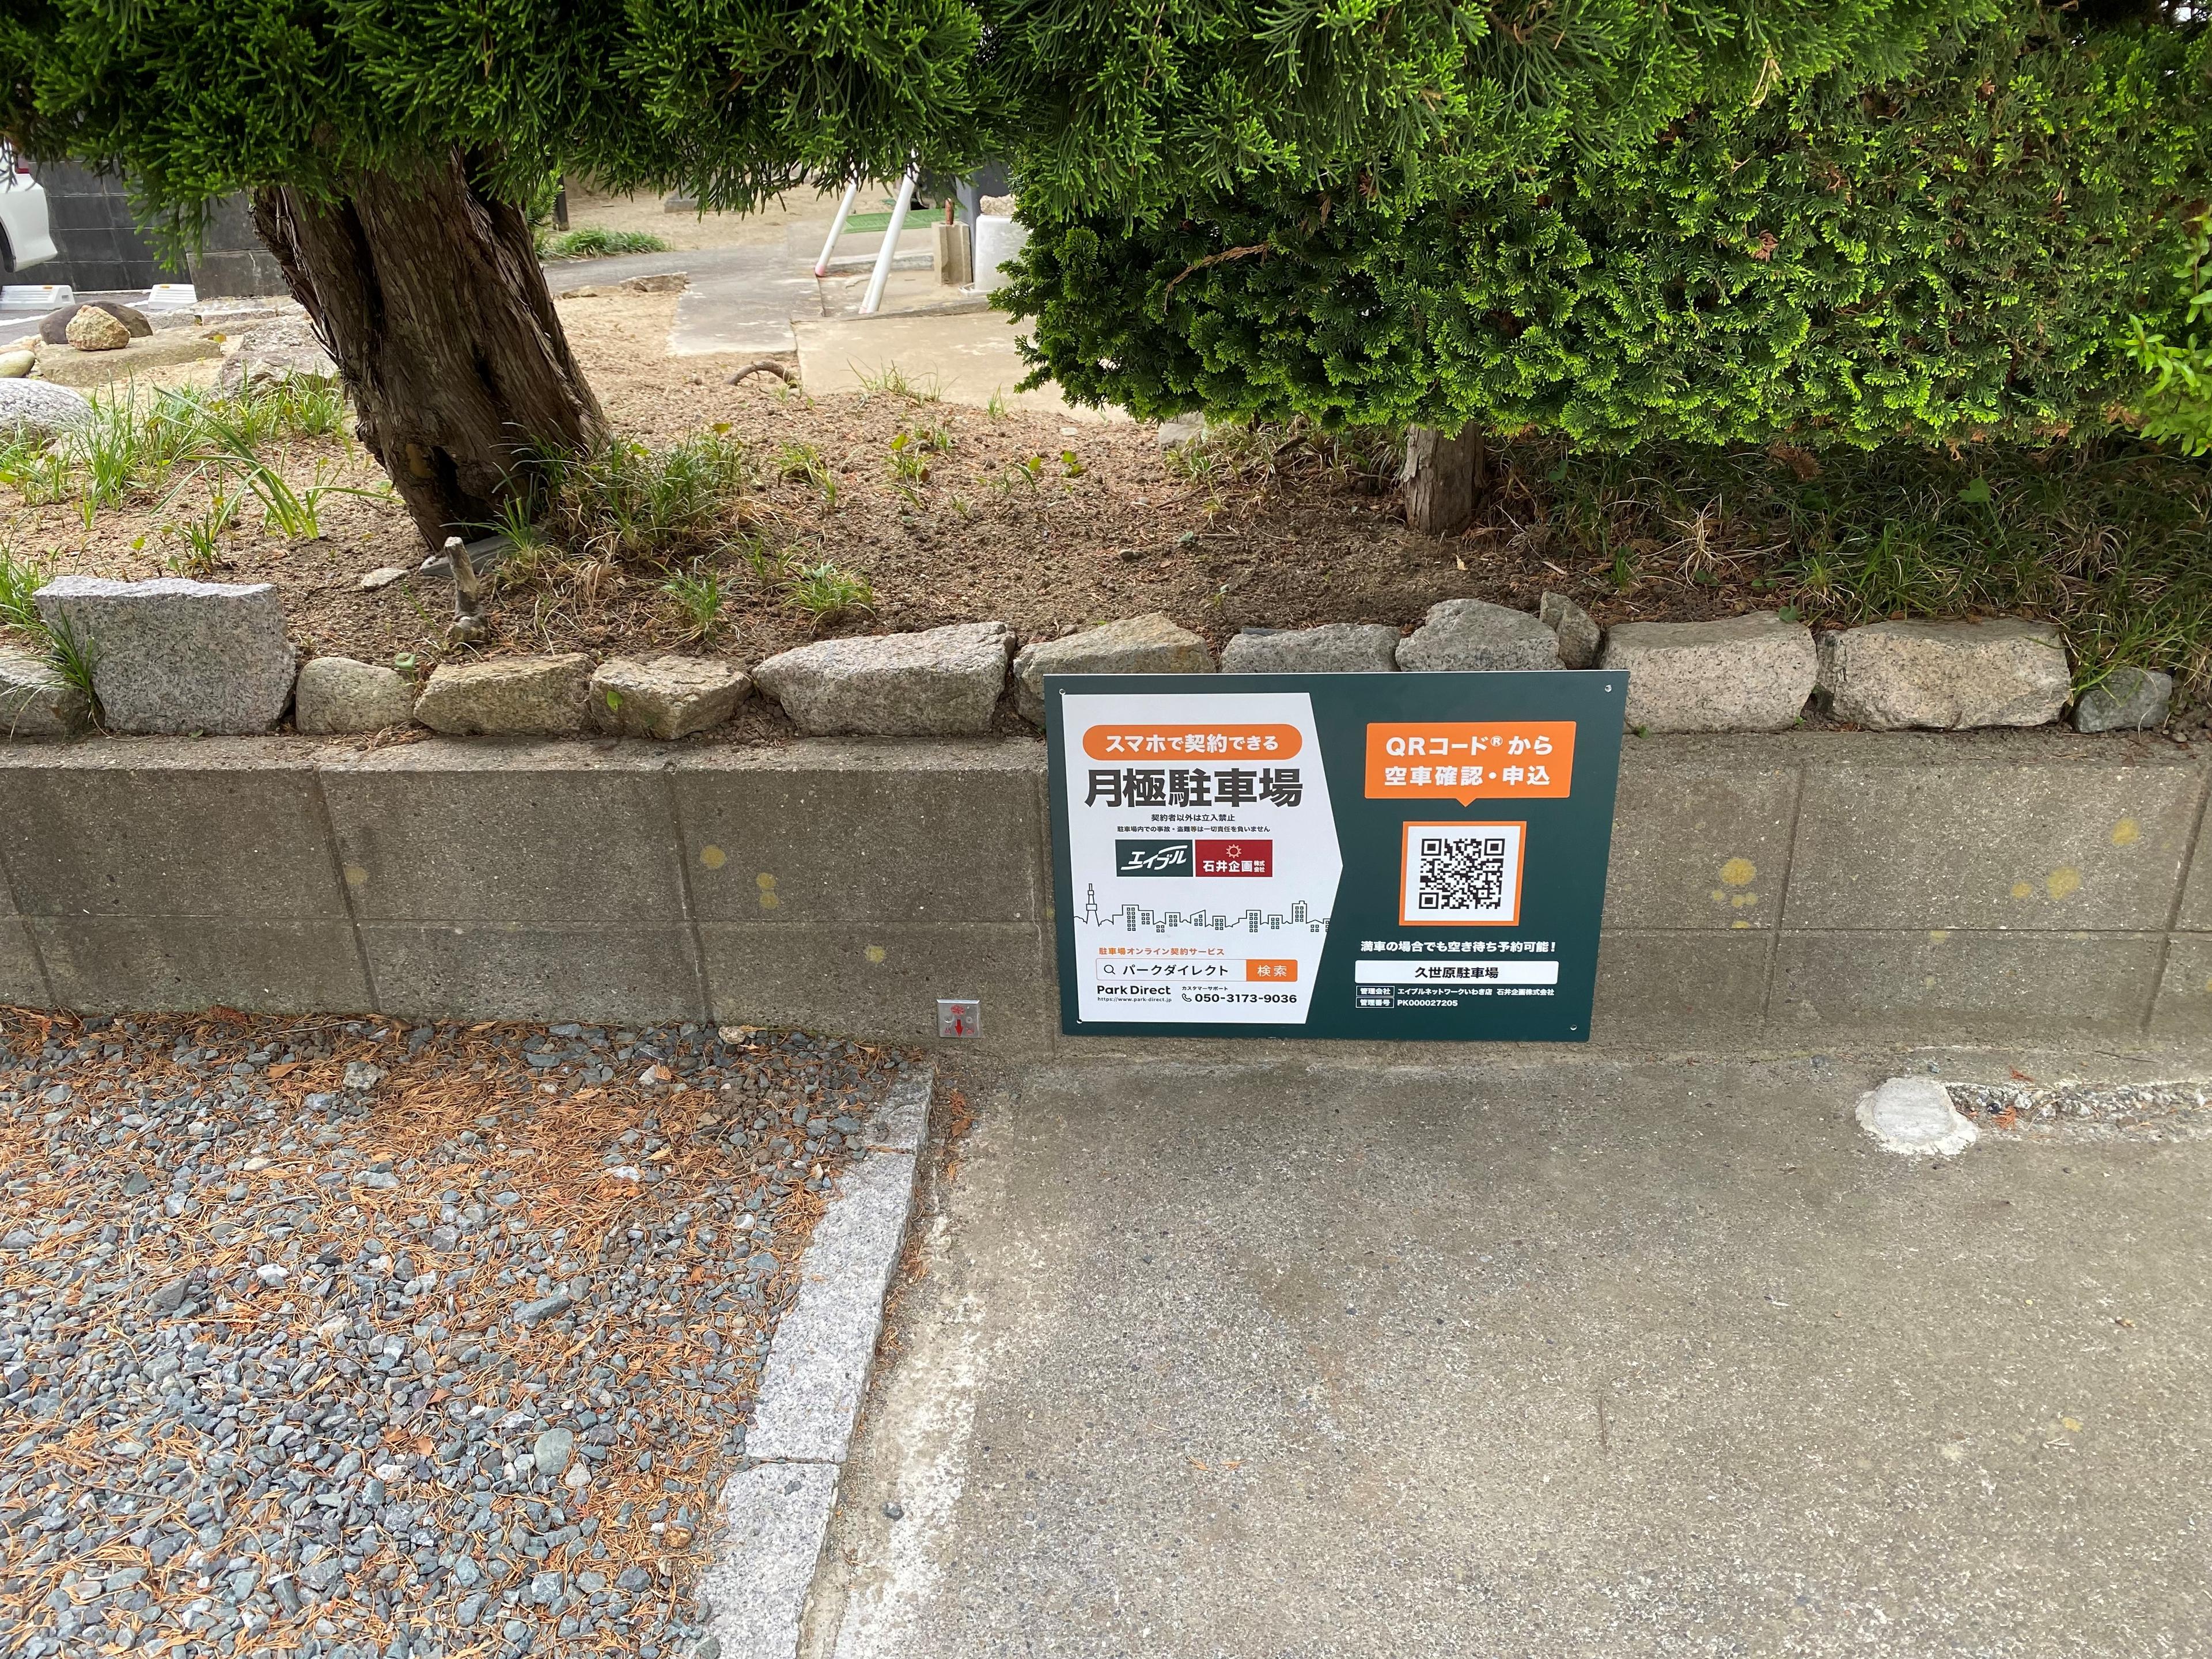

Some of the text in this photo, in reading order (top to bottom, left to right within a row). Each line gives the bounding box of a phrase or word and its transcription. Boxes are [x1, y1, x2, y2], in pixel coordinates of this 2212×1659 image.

[1105, 733, 1278, 753] スマホで契約できる
[1384, 766, 1550, 786] 空車確認・申込
[1085, 768, 1303, 808] 月極駐車場
[1151, 814, 1236, 822] 契約者以外は立入禁止
[1120, 845, 1188, 870] エイブル
[1099, 948, 1225, 956] 駐車場オンライン契約サービス
[1123, 964, 1229, 976] パークダイレクト
[1257, 964, 1287, 977] 検索
[1414, 967, 1499, 979] 久世原駐車場
[1097, 985, 1171, 995] Park Direct
[1195, 994, 1297, 1003] 050-3173-9036
